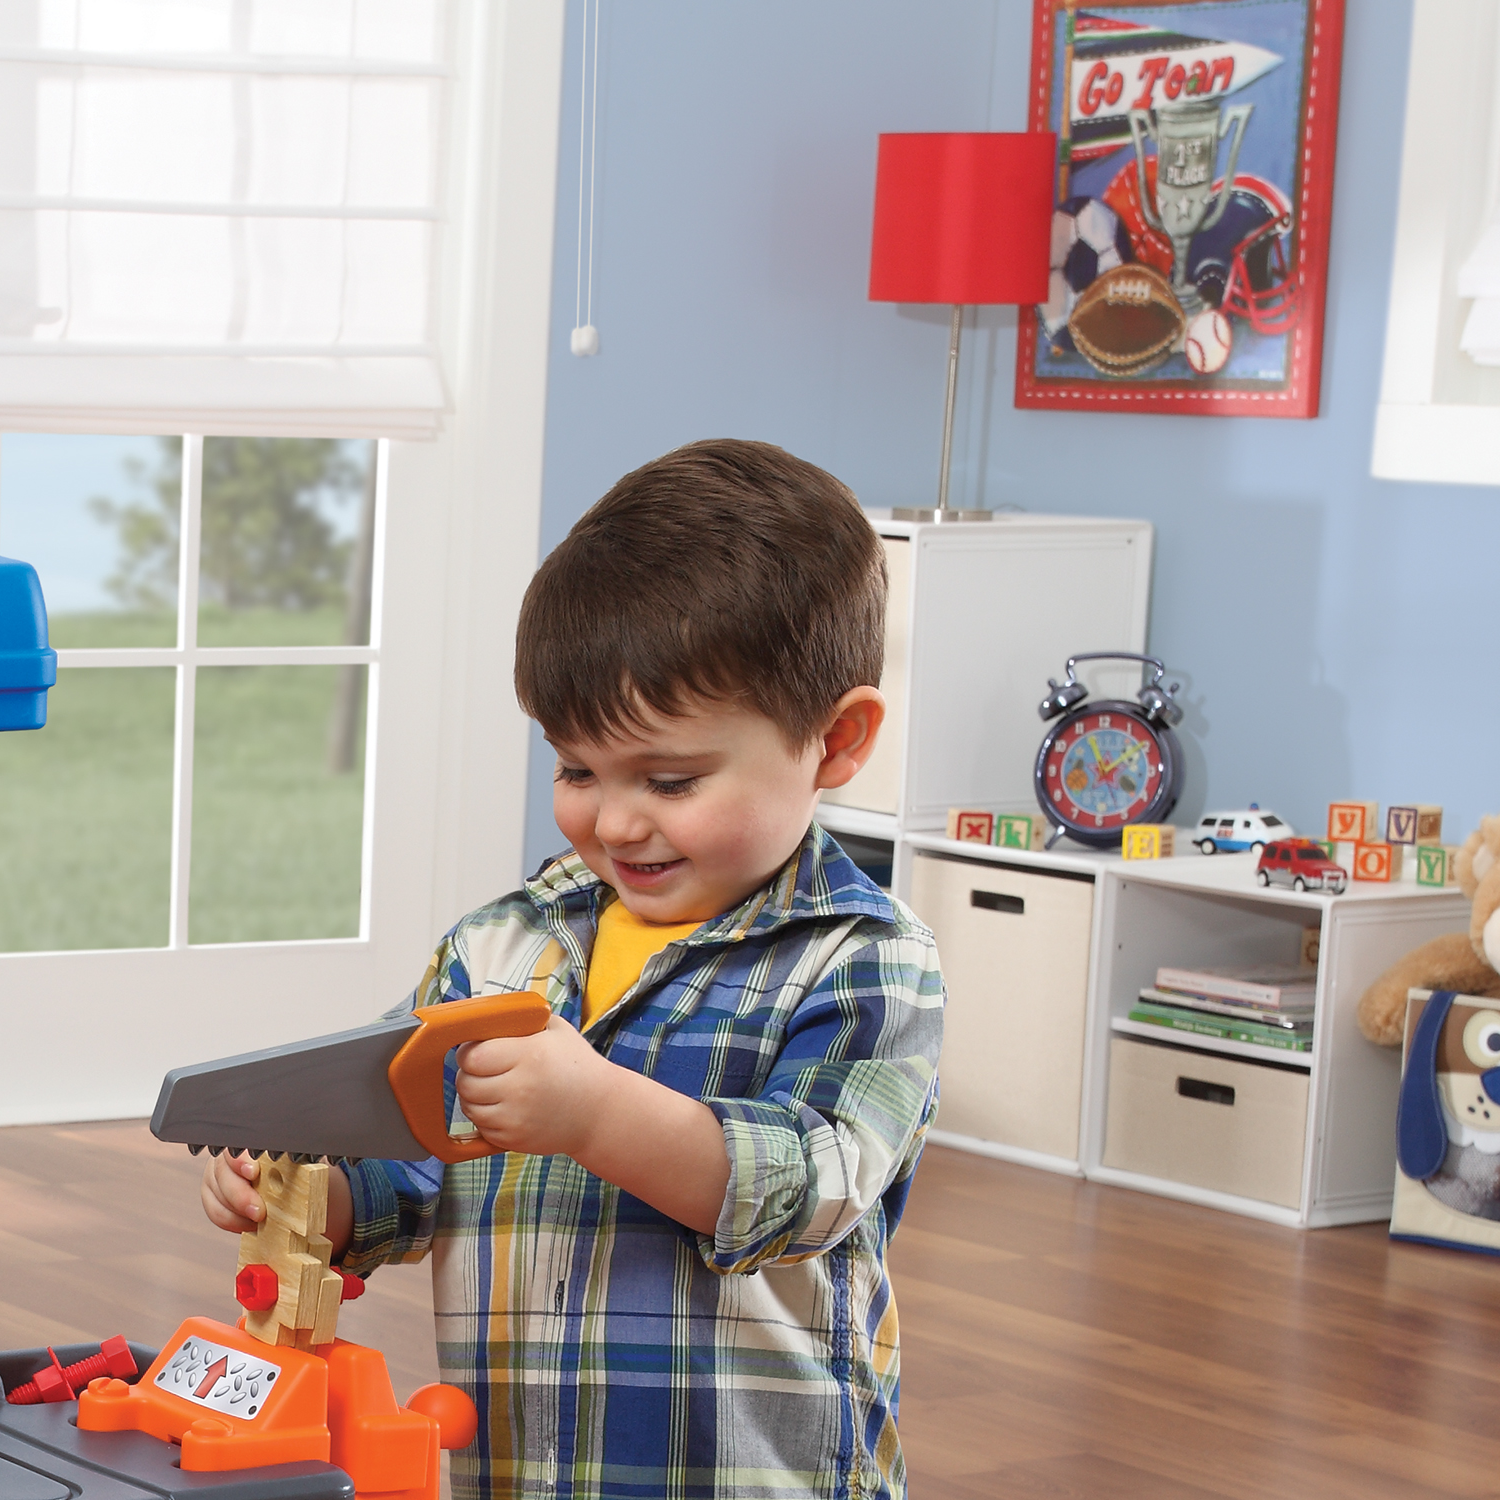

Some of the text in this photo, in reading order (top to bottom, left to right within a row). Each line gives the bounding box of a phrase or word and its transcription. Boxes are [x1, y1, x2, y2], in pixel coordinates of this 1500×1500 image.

[1078, 60, 1124, 117] Go
[1166, 165, 1208, 186] PLACE
[1075, 722, 1085, 735] 11
[1099, 716, 1111, 729] 12
[1055, 741, 1067, 753] 10
[1048, 764, 1057, 777] 9
[1071, 807, 1079, 819] 7
[1094, 815, 1103, 827] 6
[1130, 833, 1150, 859] E
